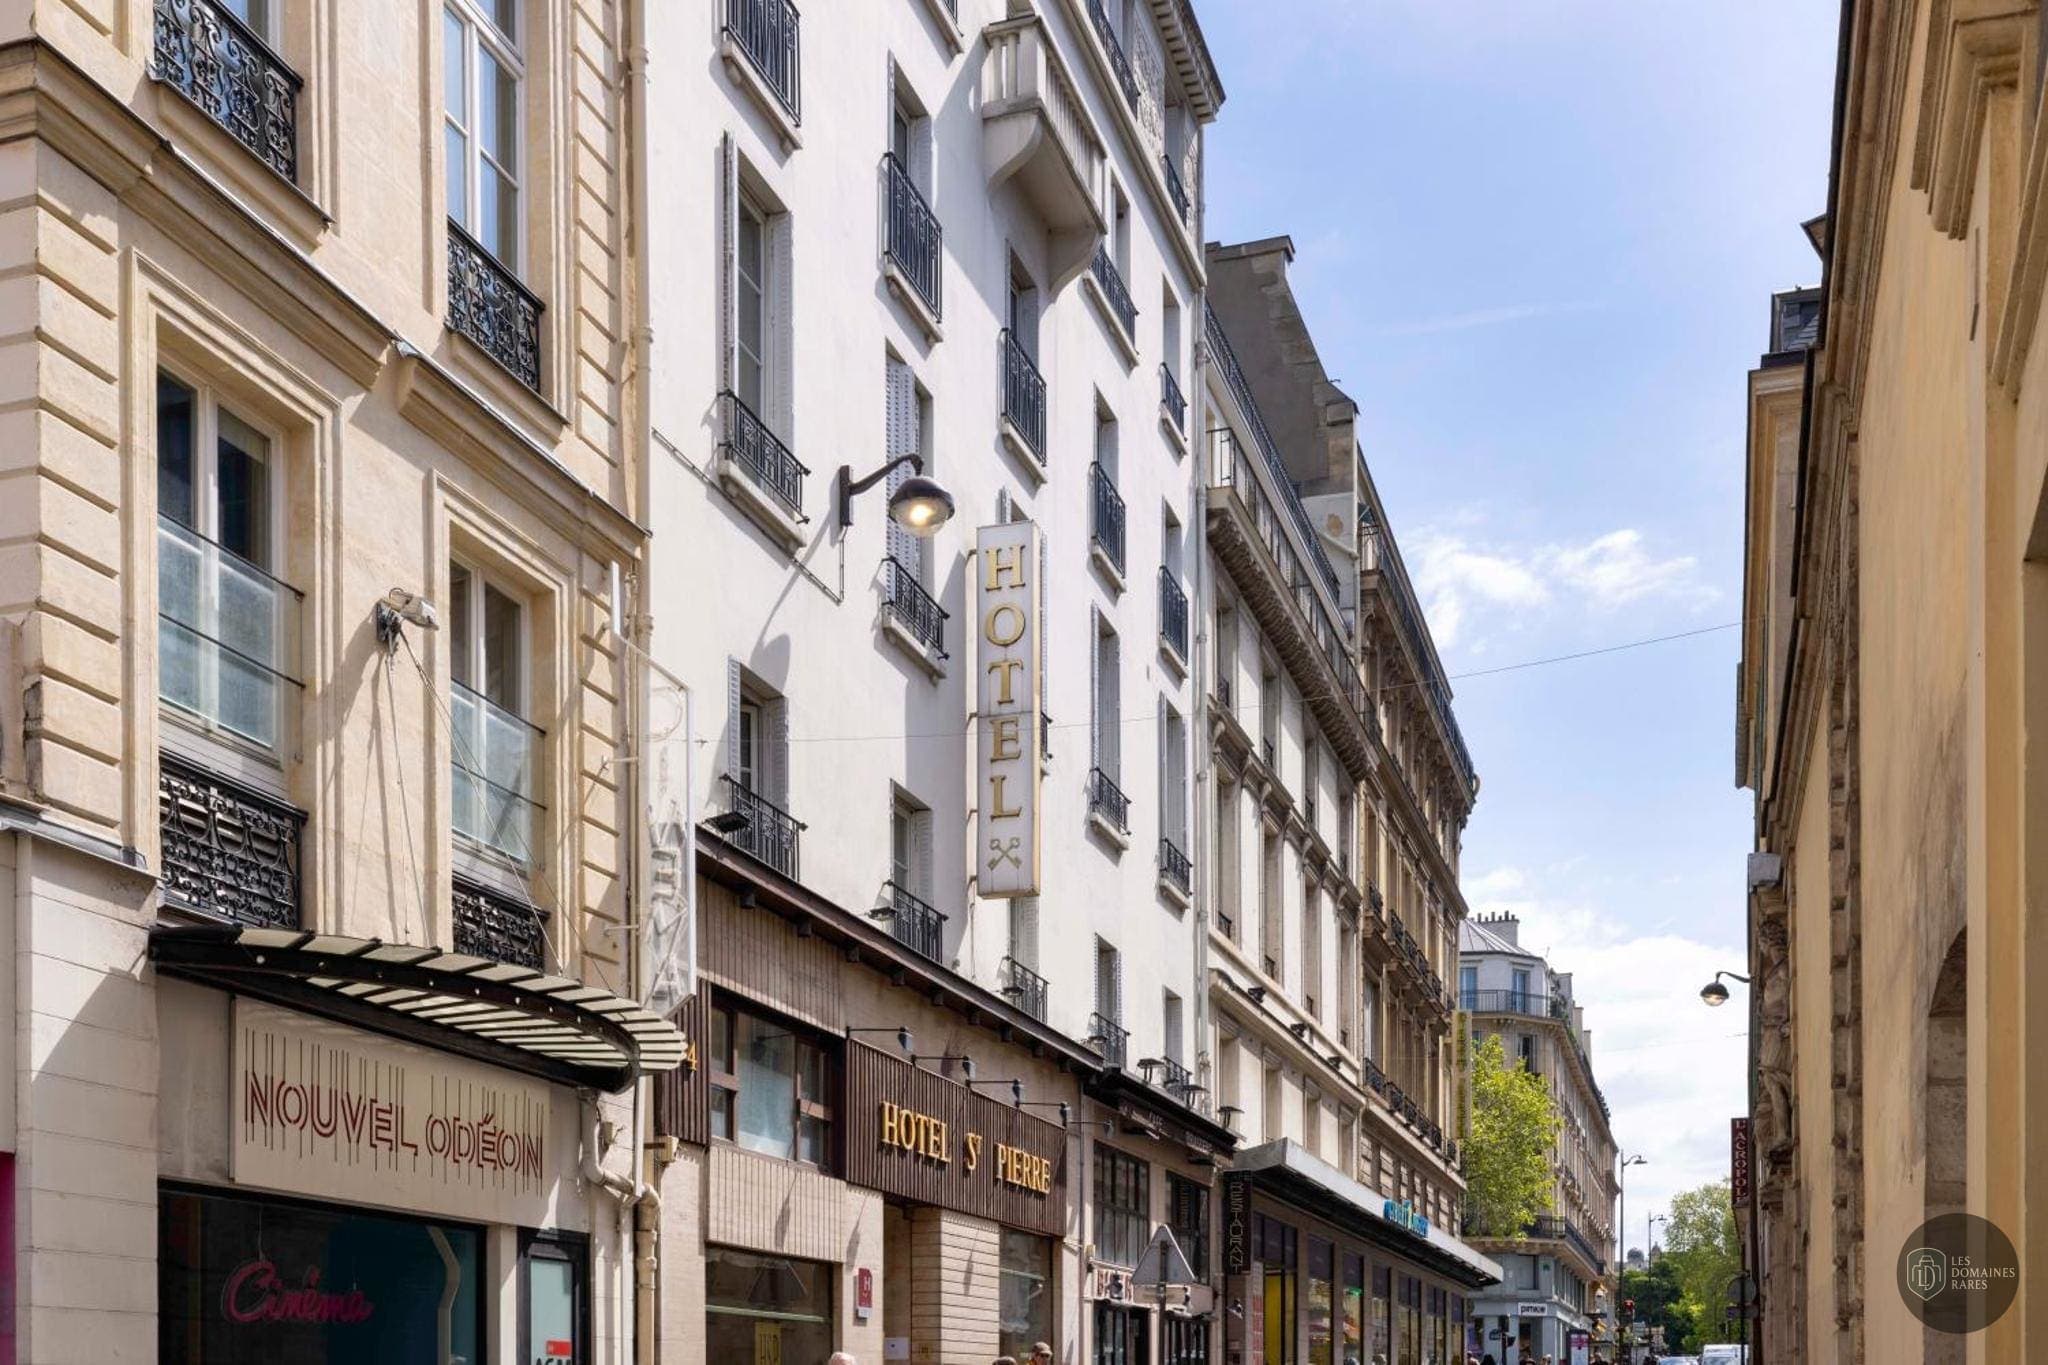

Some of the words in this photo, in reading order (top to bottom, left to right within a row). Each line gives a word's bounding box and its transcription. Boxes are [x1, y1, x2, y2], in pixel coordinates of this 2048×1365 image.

[984, 544, 1026, 822] HOTEL
[245, 1064, 419, 1160] NOUVEL
[426, 1110, 543, 1181] ODÉON
[882, 1100, 951, 1163] HOTEL
[996, 1142, 1051, 1195] PIERRE
[1229, 1181, 1244, 1274] RESTAURANT
[222, 1260, 375, 1323] Cinéma
